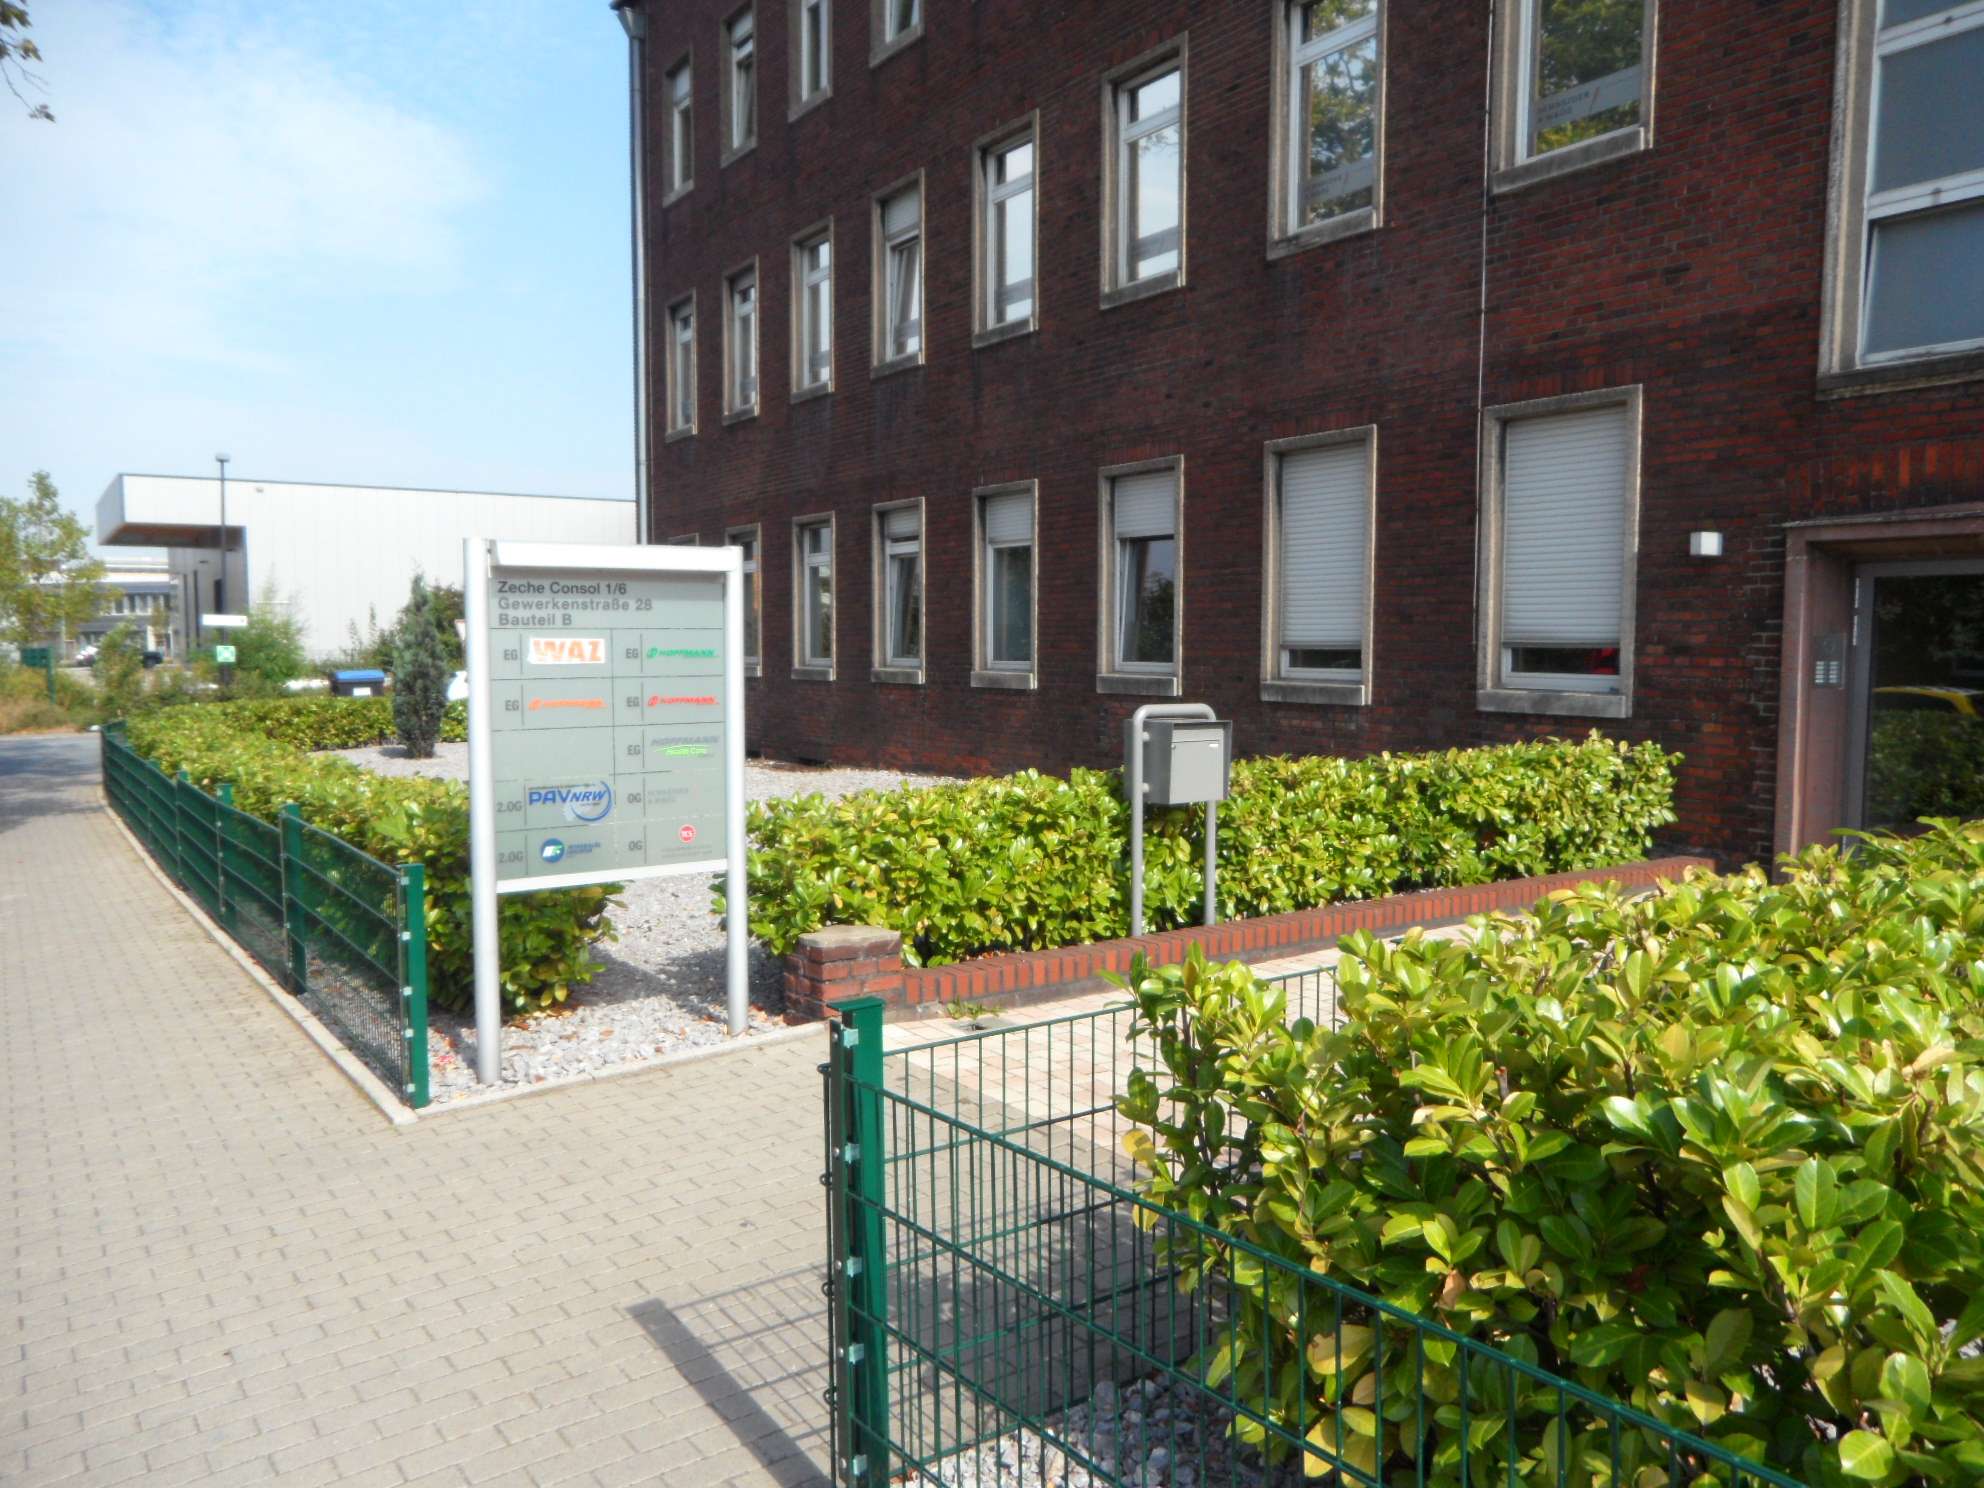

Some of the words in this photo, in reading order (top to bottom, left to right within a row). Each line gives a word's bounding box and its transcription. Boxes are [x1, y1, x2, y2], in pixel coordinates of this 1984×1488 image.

[497, 581, 545, 594] Zeche
[550, 582, 601, 595] Consol
[605, 583, 627, 595] 1/6
[498, 597, 630, 611] Gewerkenstraße
[498, 613, 556, 626] Bauteil
[561, 613, 573, 626] B
[503, 649, 519, 661] EG
[625, 647, 640, 660] EG
[504, 699, 520, 711] EG
[626, 696, 641, 708] EG
[626, 744, 642, 756] EG
